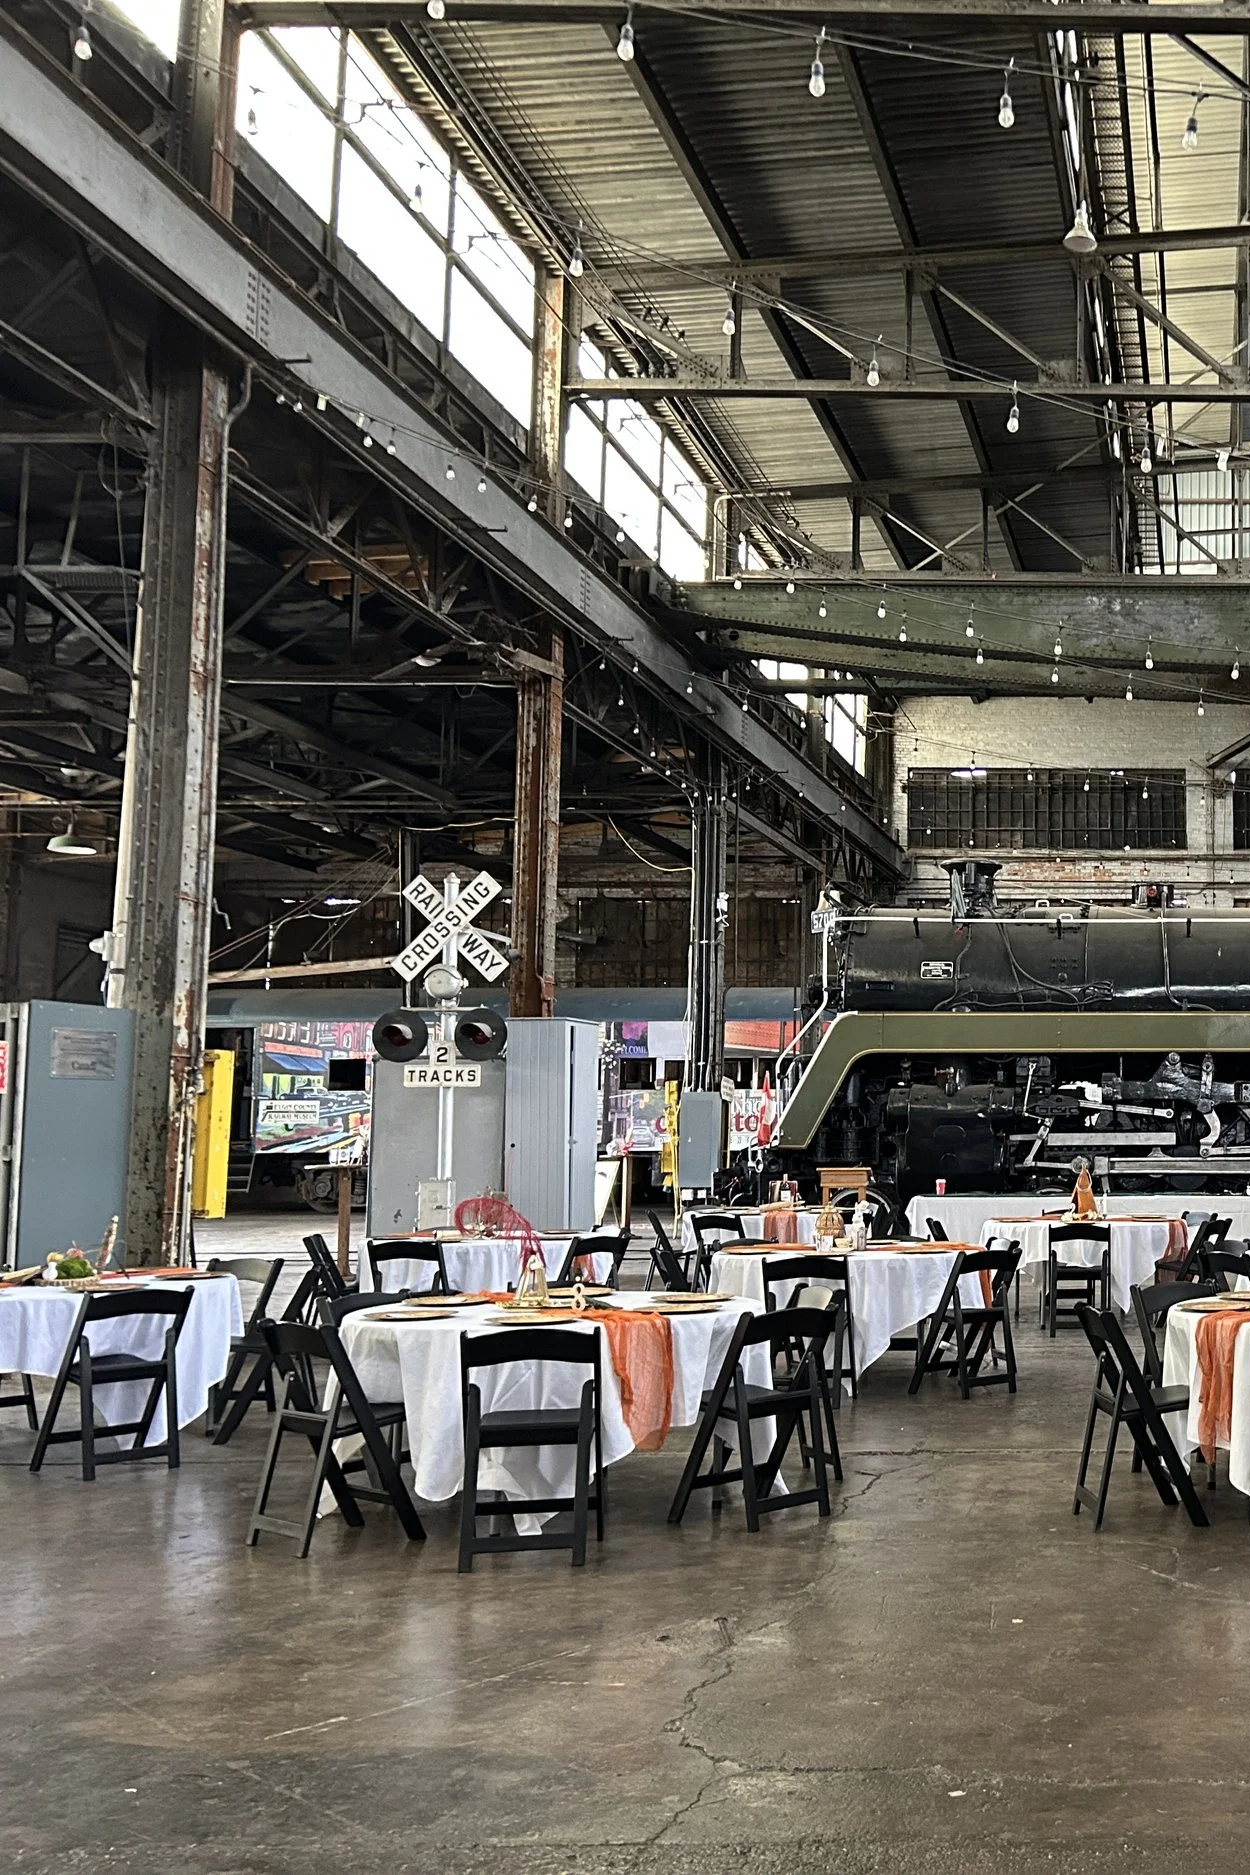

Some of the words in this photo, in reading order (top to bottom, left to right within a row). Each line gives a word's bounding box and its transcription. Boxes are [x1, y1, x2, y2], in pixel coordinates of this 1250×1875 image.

[401, 882, 490, 972] CROSSING
[462, 933, 503, 972] WAY
[436, 1047, 448, 1062] 2
[408, 1070, 476, 1082] TRACKS
[571, 1283, 586, 1310] 8
